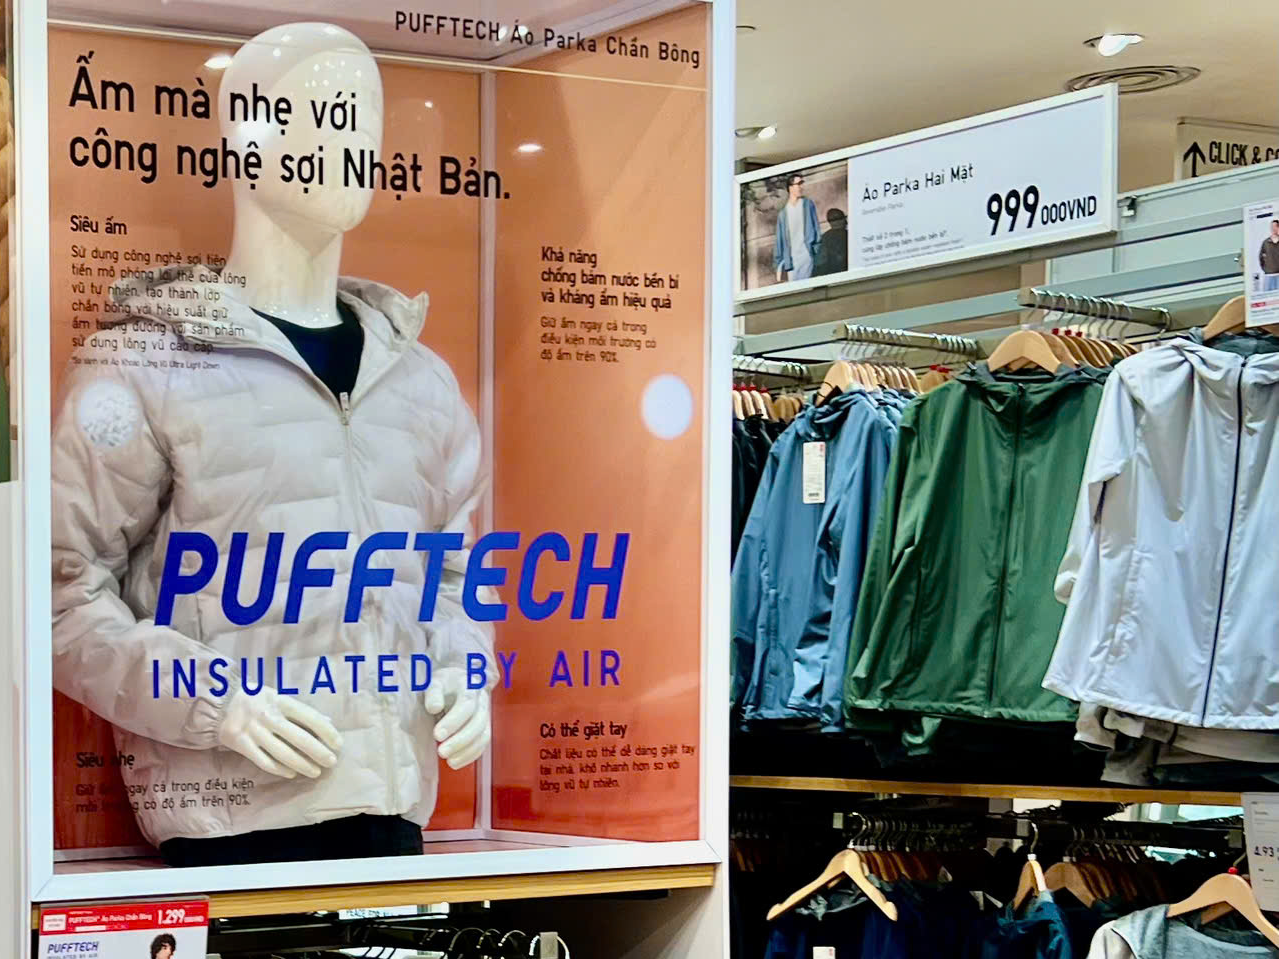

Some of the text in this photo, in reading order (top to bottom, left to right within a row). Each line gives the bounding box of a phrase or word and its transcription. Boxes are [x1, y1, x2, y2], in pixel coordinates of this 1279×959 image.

[395, 11, 500, 41] PUFFTECH
[510, 19, 534, 46] Áo
[544, 28, 597, 54] Parka
[659, 41, 700, 69] Bông
[69, 51, 356, 136] Ấm mà nhẹ với
[70, 127, 510, 201] công nghệ sợi Nhật Bản.
[1209, 140, 1248, 166] CLICK
[862, 163, 974, 203] Áo Parka Hai Mặt
[70, 215, 127, 235] Siêu ấm
[987, 184, 1039, 236] 999
[541, 246, 597, 268] Khả năng
[154, 531, 631, 626] PUFFTECH
[152, 649, 622, 700] INSULATED BY AIR
[540, 719, 628, 740] Có thể giặt tay
[47, 941, 98, 954] PUFFTECH
